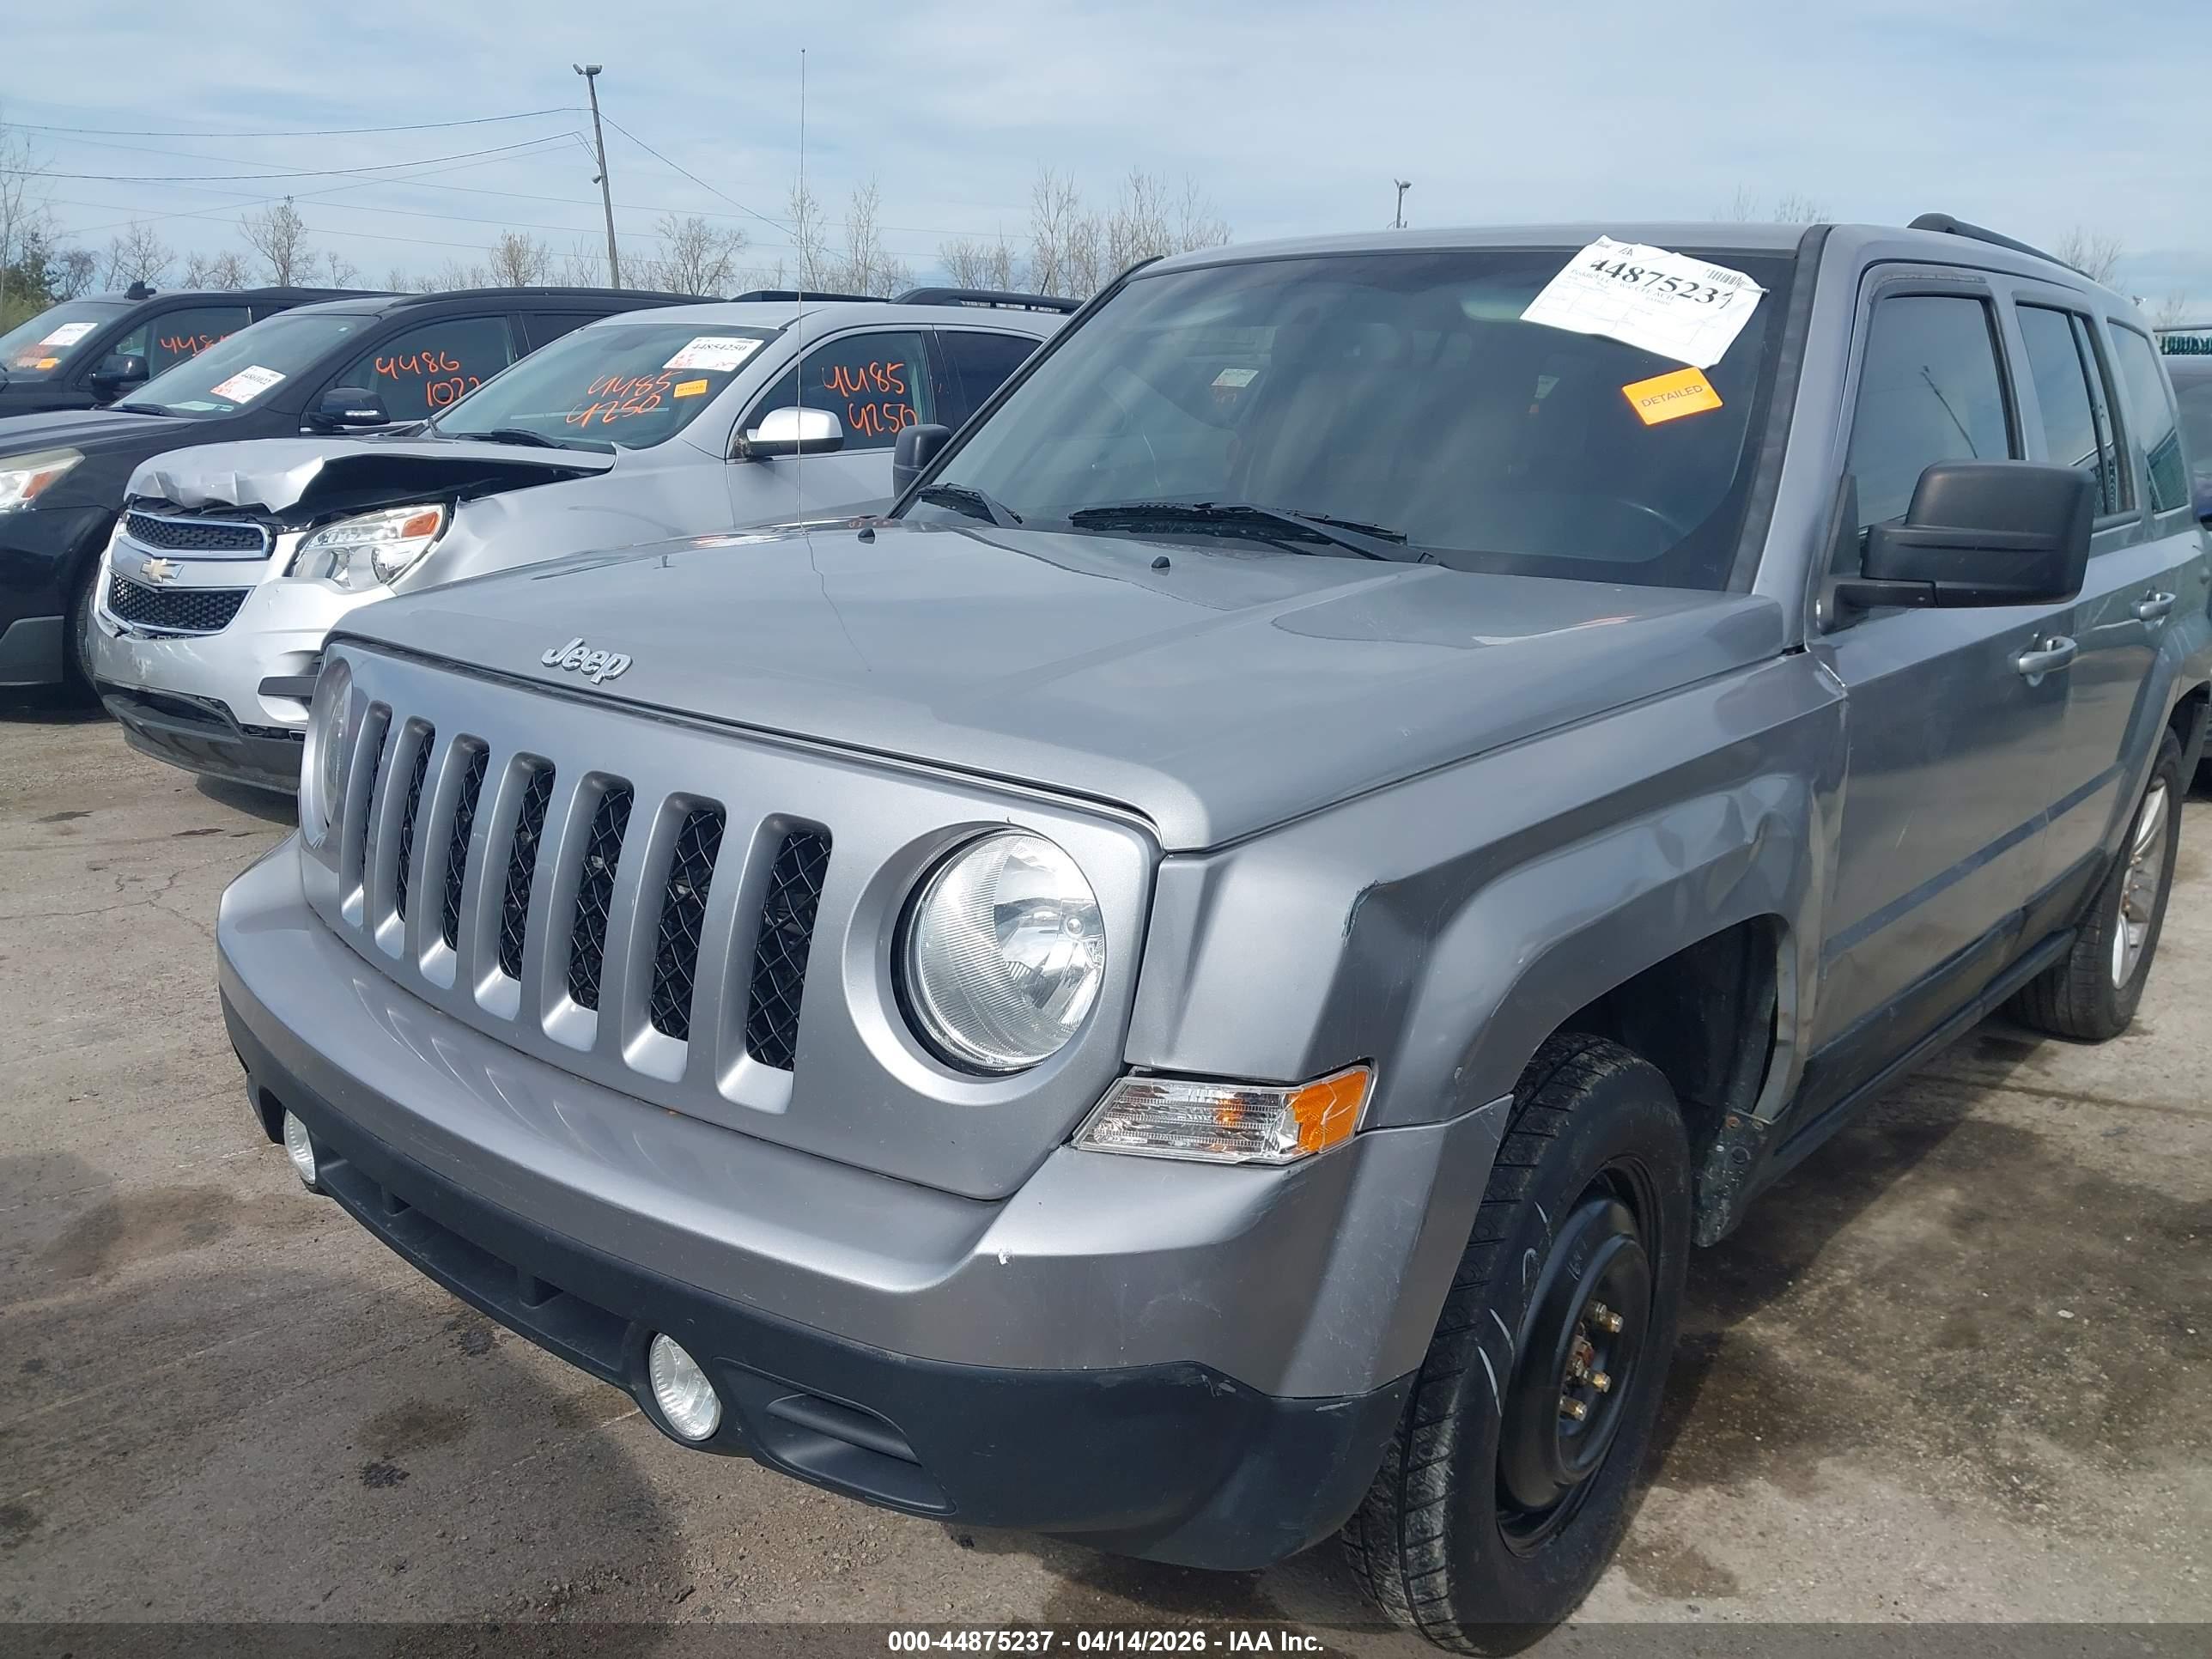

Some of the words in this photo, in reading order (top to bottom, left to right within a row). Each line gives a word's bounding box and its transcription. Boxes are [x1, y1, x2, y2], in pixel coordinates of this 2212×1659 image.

[375, 350, 461, 380] 4486
[820, 362, 905, 398] 4485
[586, 370, 684, 398] 4485
[1641, 385, 1704, 407] DETAILED
[542, 636, 633, 685] Jeep
